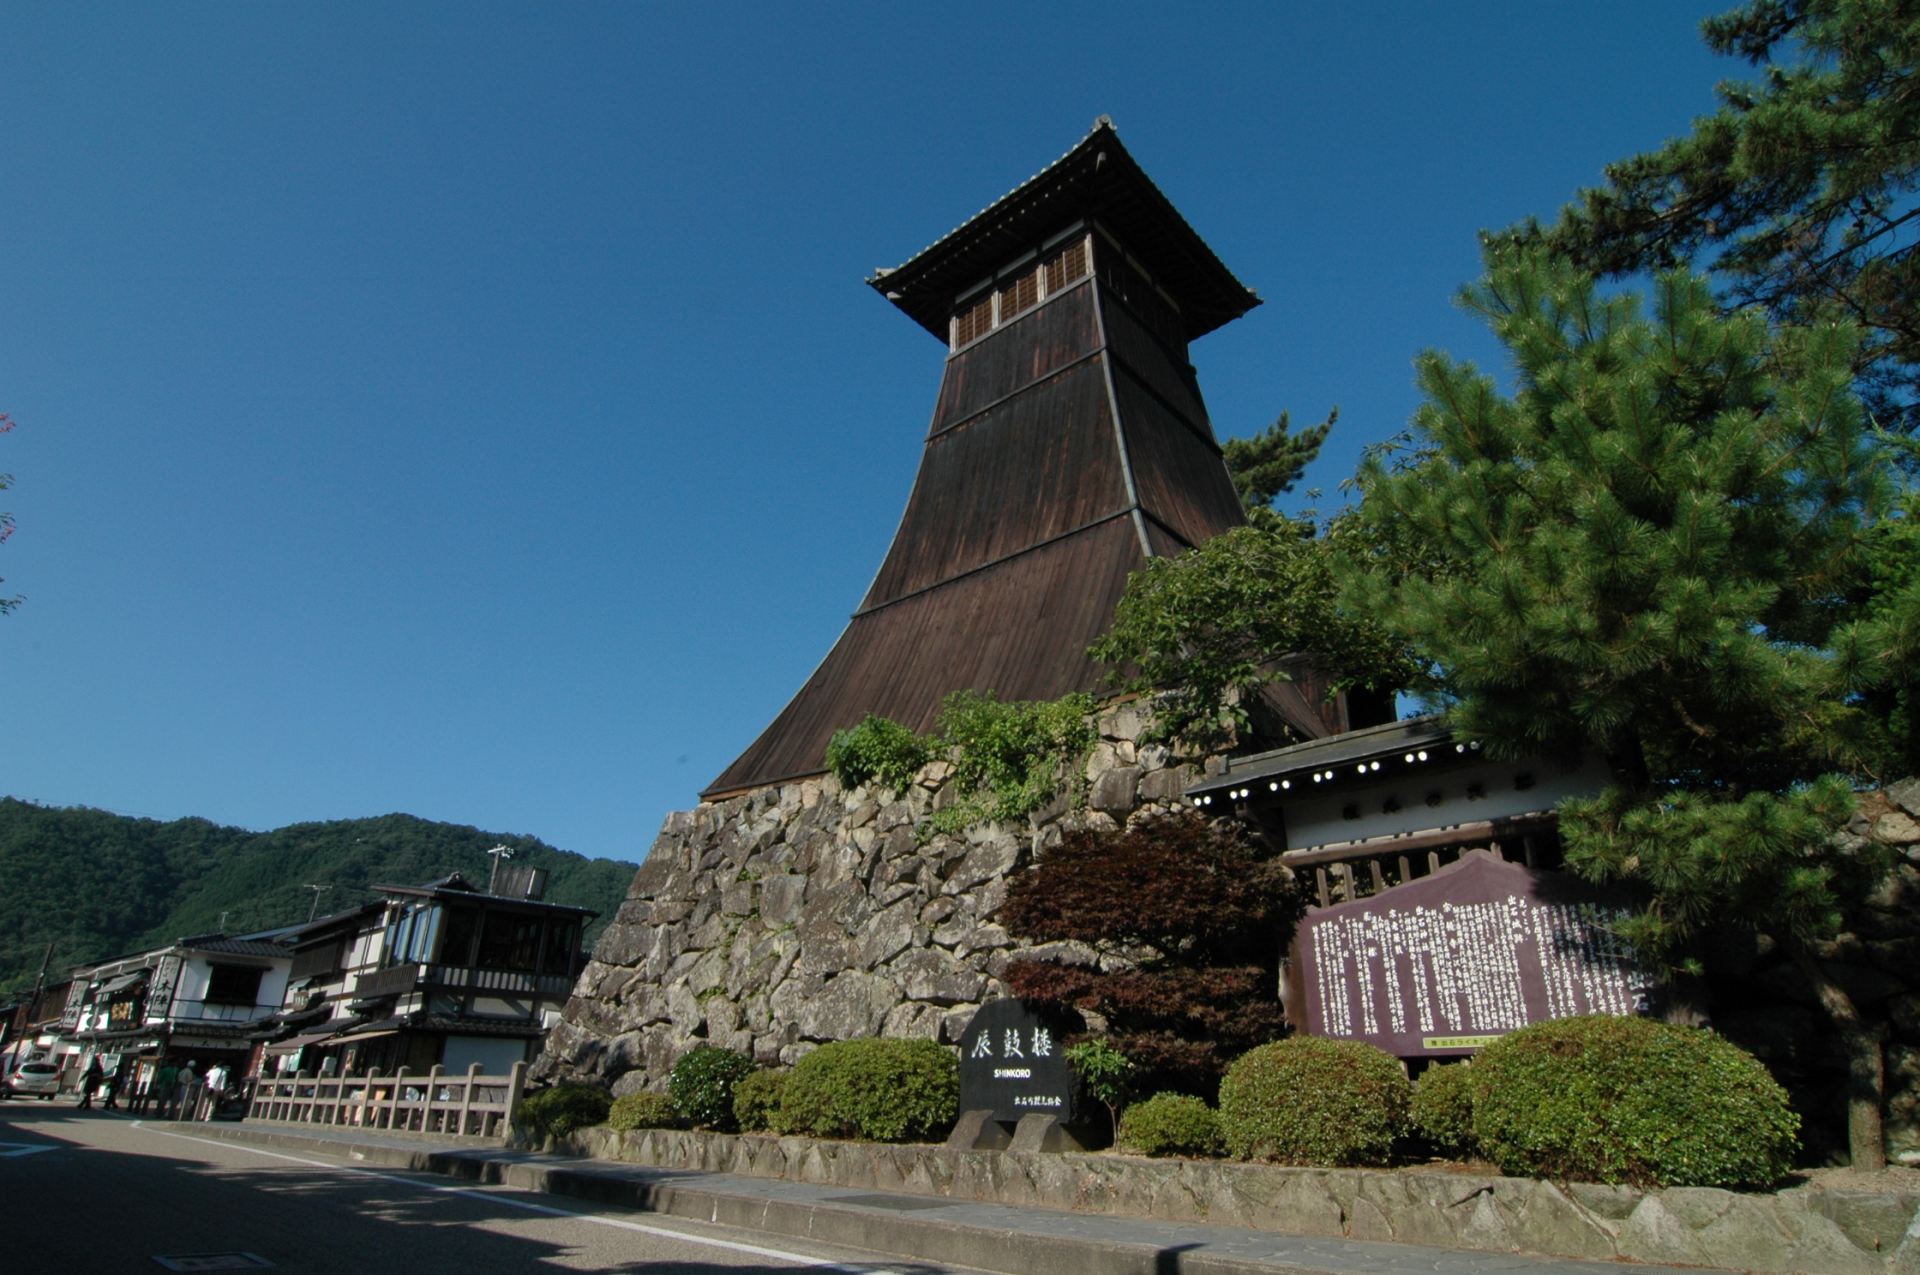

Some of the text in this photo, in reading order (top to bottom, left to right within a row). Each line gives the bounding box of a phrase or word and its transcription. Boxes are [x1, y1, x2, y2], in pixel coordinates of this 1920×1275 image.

[971, 1026, 1052, 1058] 辰鼓楼
[994, 1069, 1031, 1078] SHINKORO
